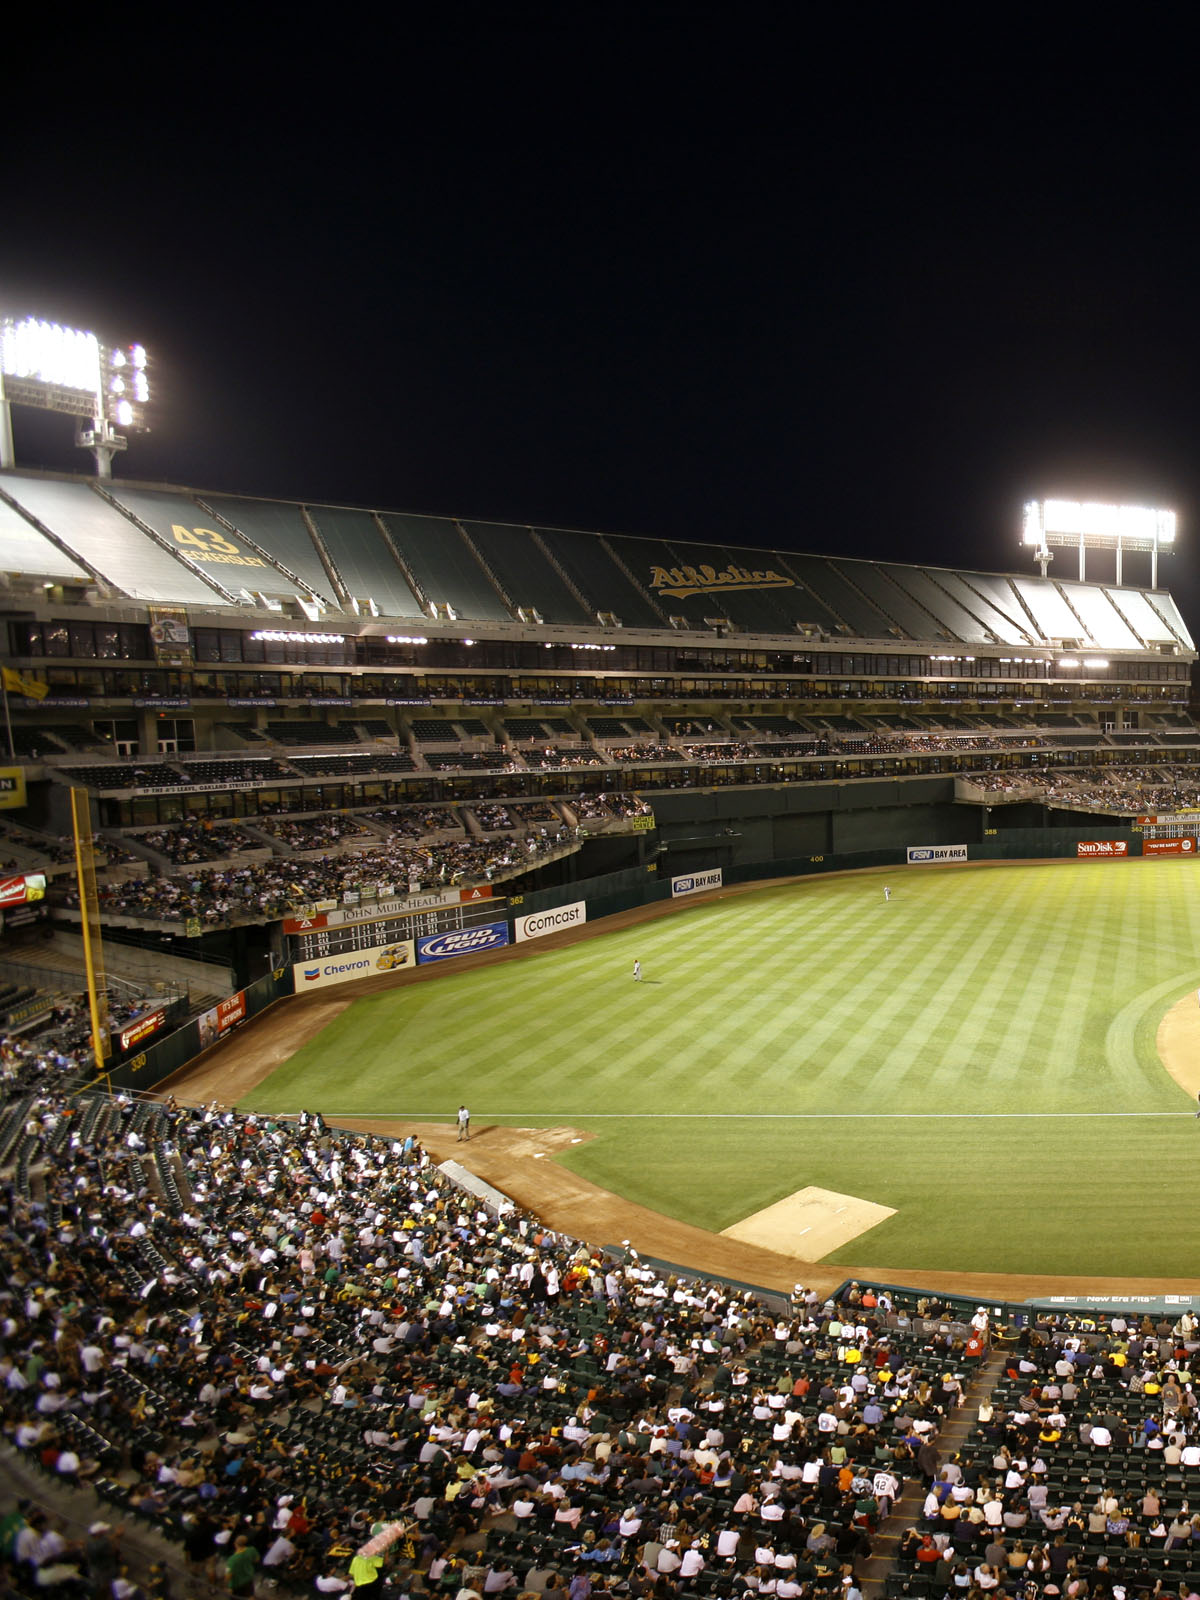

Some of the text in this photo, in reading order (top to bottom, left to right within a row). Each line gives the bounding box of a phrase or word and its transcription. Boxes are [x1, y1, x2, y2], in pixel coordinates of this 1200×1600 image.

[171, 524, 240, 555] 43
[649, 565, 786, 590] Athletics
[199, 783, 228, 791] OAKLAND
[911, 848, 966, 860] FSN BAY AREA
[1078, 842, 1113, 852] SanDisk
[675, 873, 722, 892] FSN BAY AREA
[343, 895, 447, 921] JOHN MUIR HEALTH
[510, 896, 524, 906] 362
[526, 907, 580, 934] comcast
[434, 934, 501, 953] LIGHT
[444, 929, 493, 944] BUD
[324, 959, 370, 976] Chevron
[222, 996, 240, 1013] IT'S THE
[222, 1007, 242, 1027] NETWORK
[130, 1053, 146, 1072] 330
[874, 1480, 887, 1491] 42
